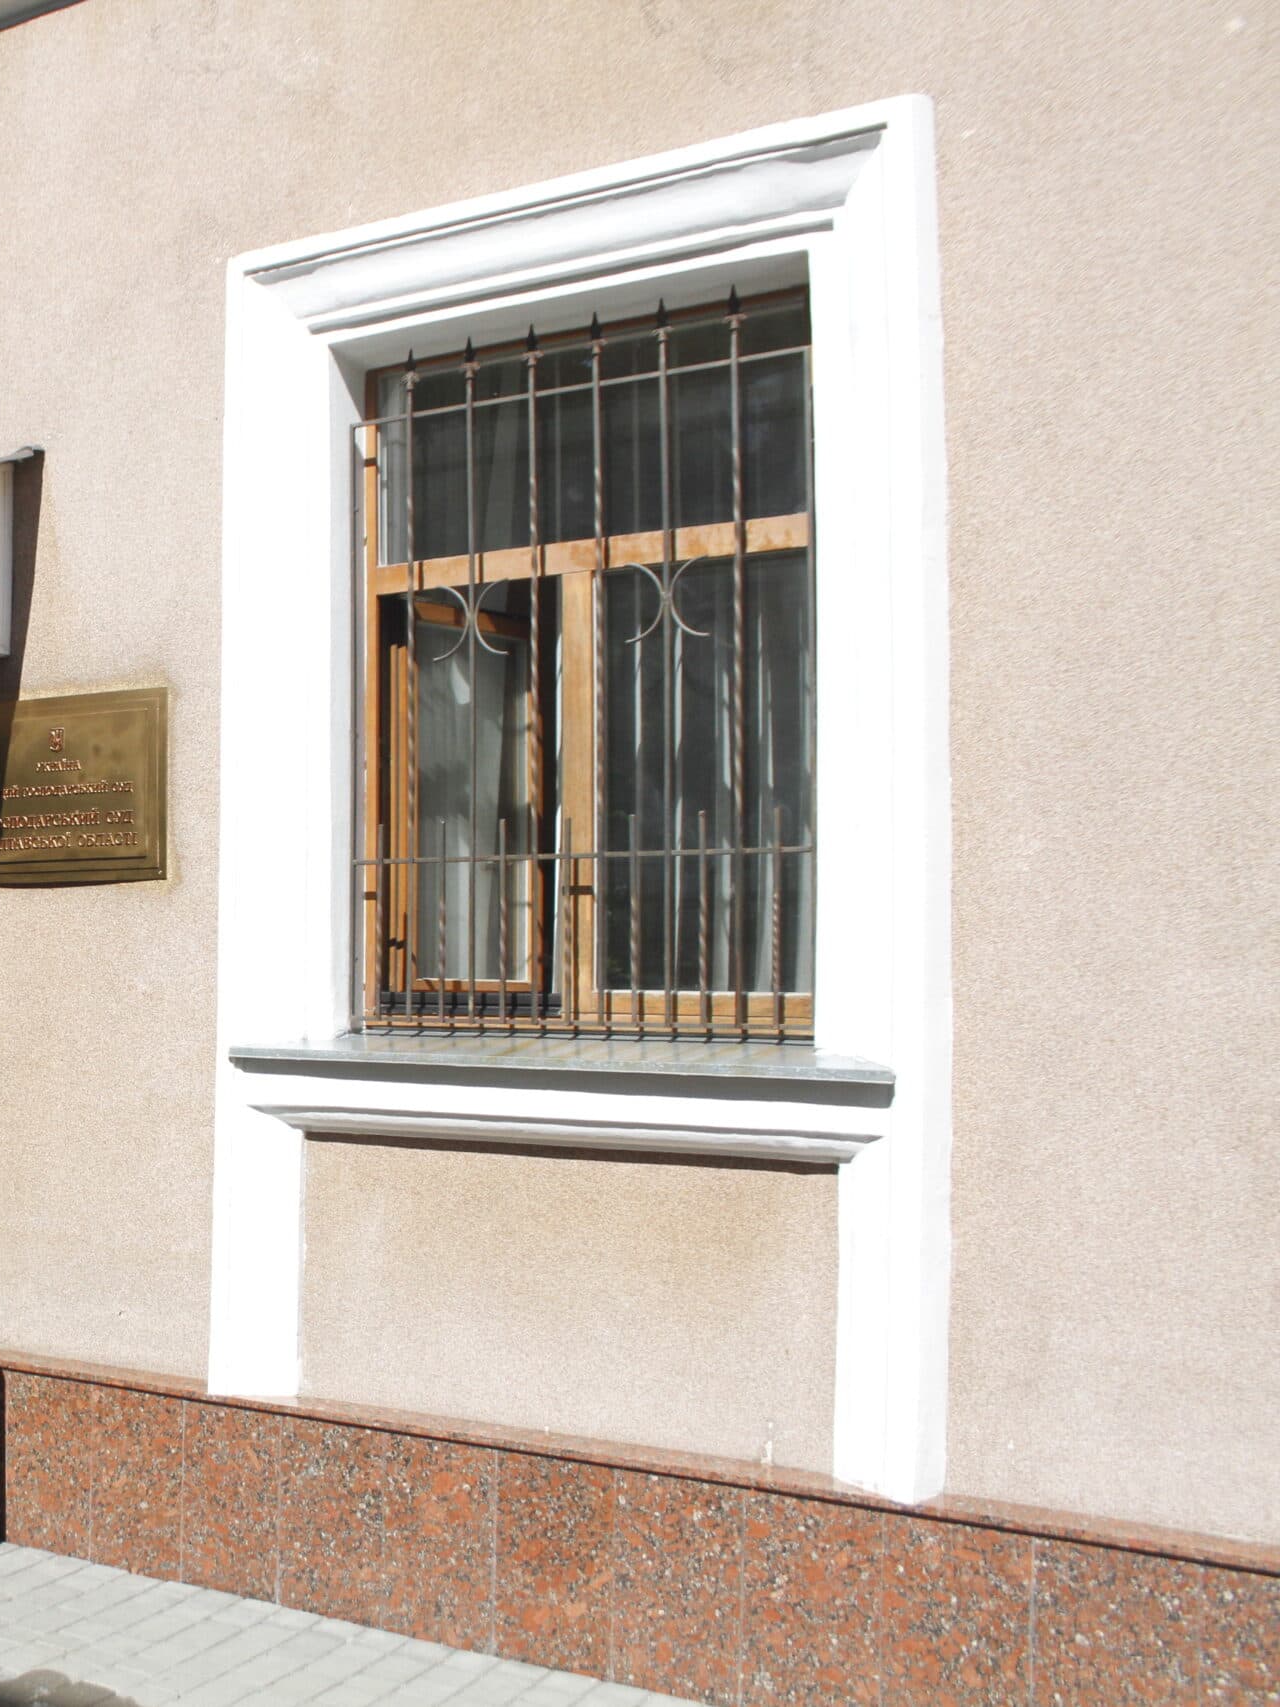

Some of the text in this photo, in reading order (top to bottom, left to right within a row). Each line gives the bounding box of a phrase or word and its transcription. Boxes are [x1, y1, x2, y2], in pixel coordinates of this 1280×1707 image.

[111, 781, 134, 794] СУД
[106, 810, 135, 826] СУД
[78, 832, 138, 847] ОБЛАСТІ
